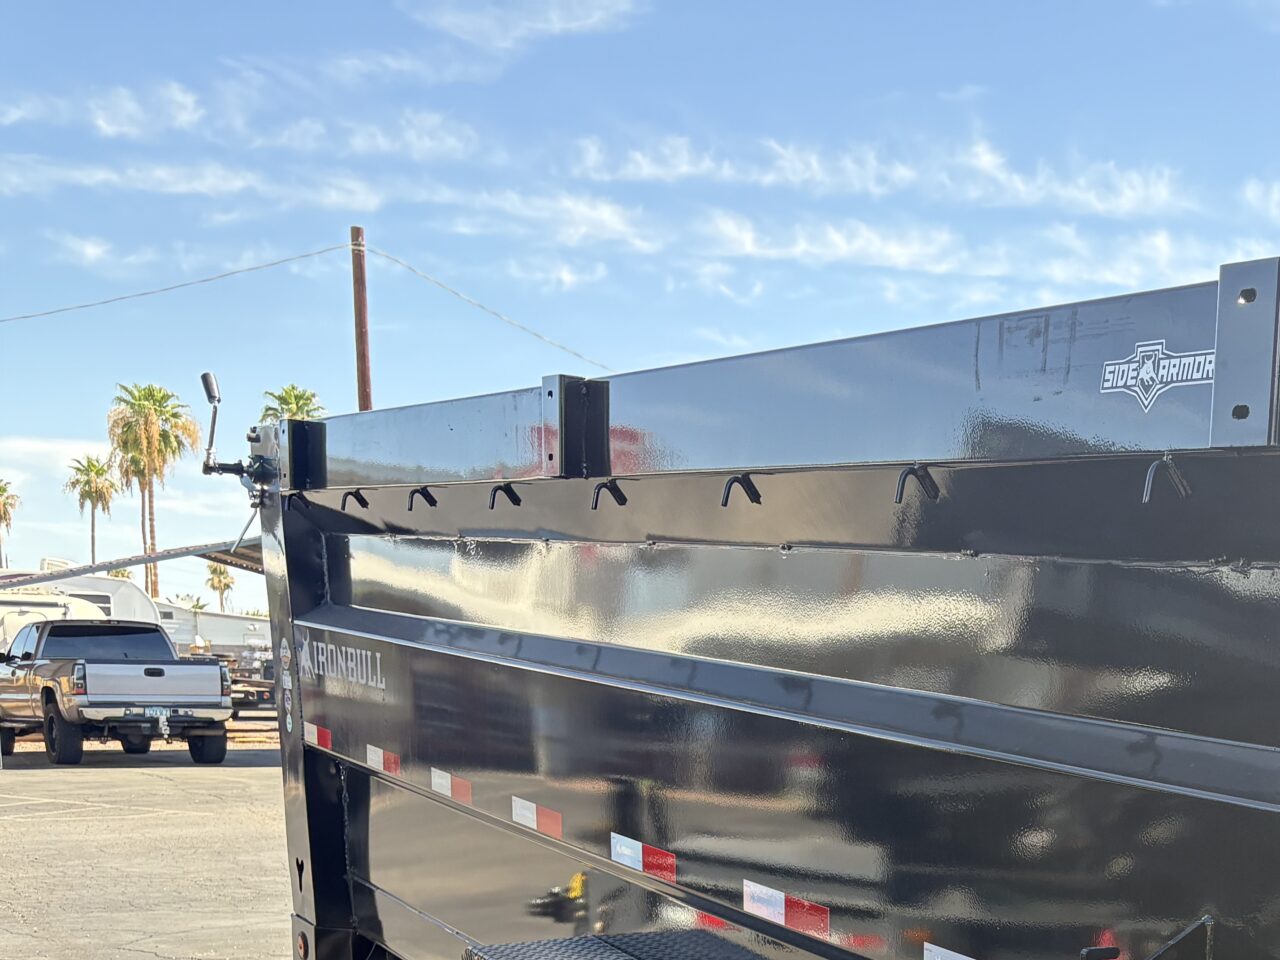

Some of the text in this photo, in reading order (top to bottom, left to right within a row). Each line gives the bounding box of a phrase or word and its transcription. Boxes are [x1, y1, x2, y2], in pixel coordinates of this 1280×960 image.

[1103, 354, 1215, 388] SIDE ARMOR
[312, 641, 386, 689] IRONBULL
